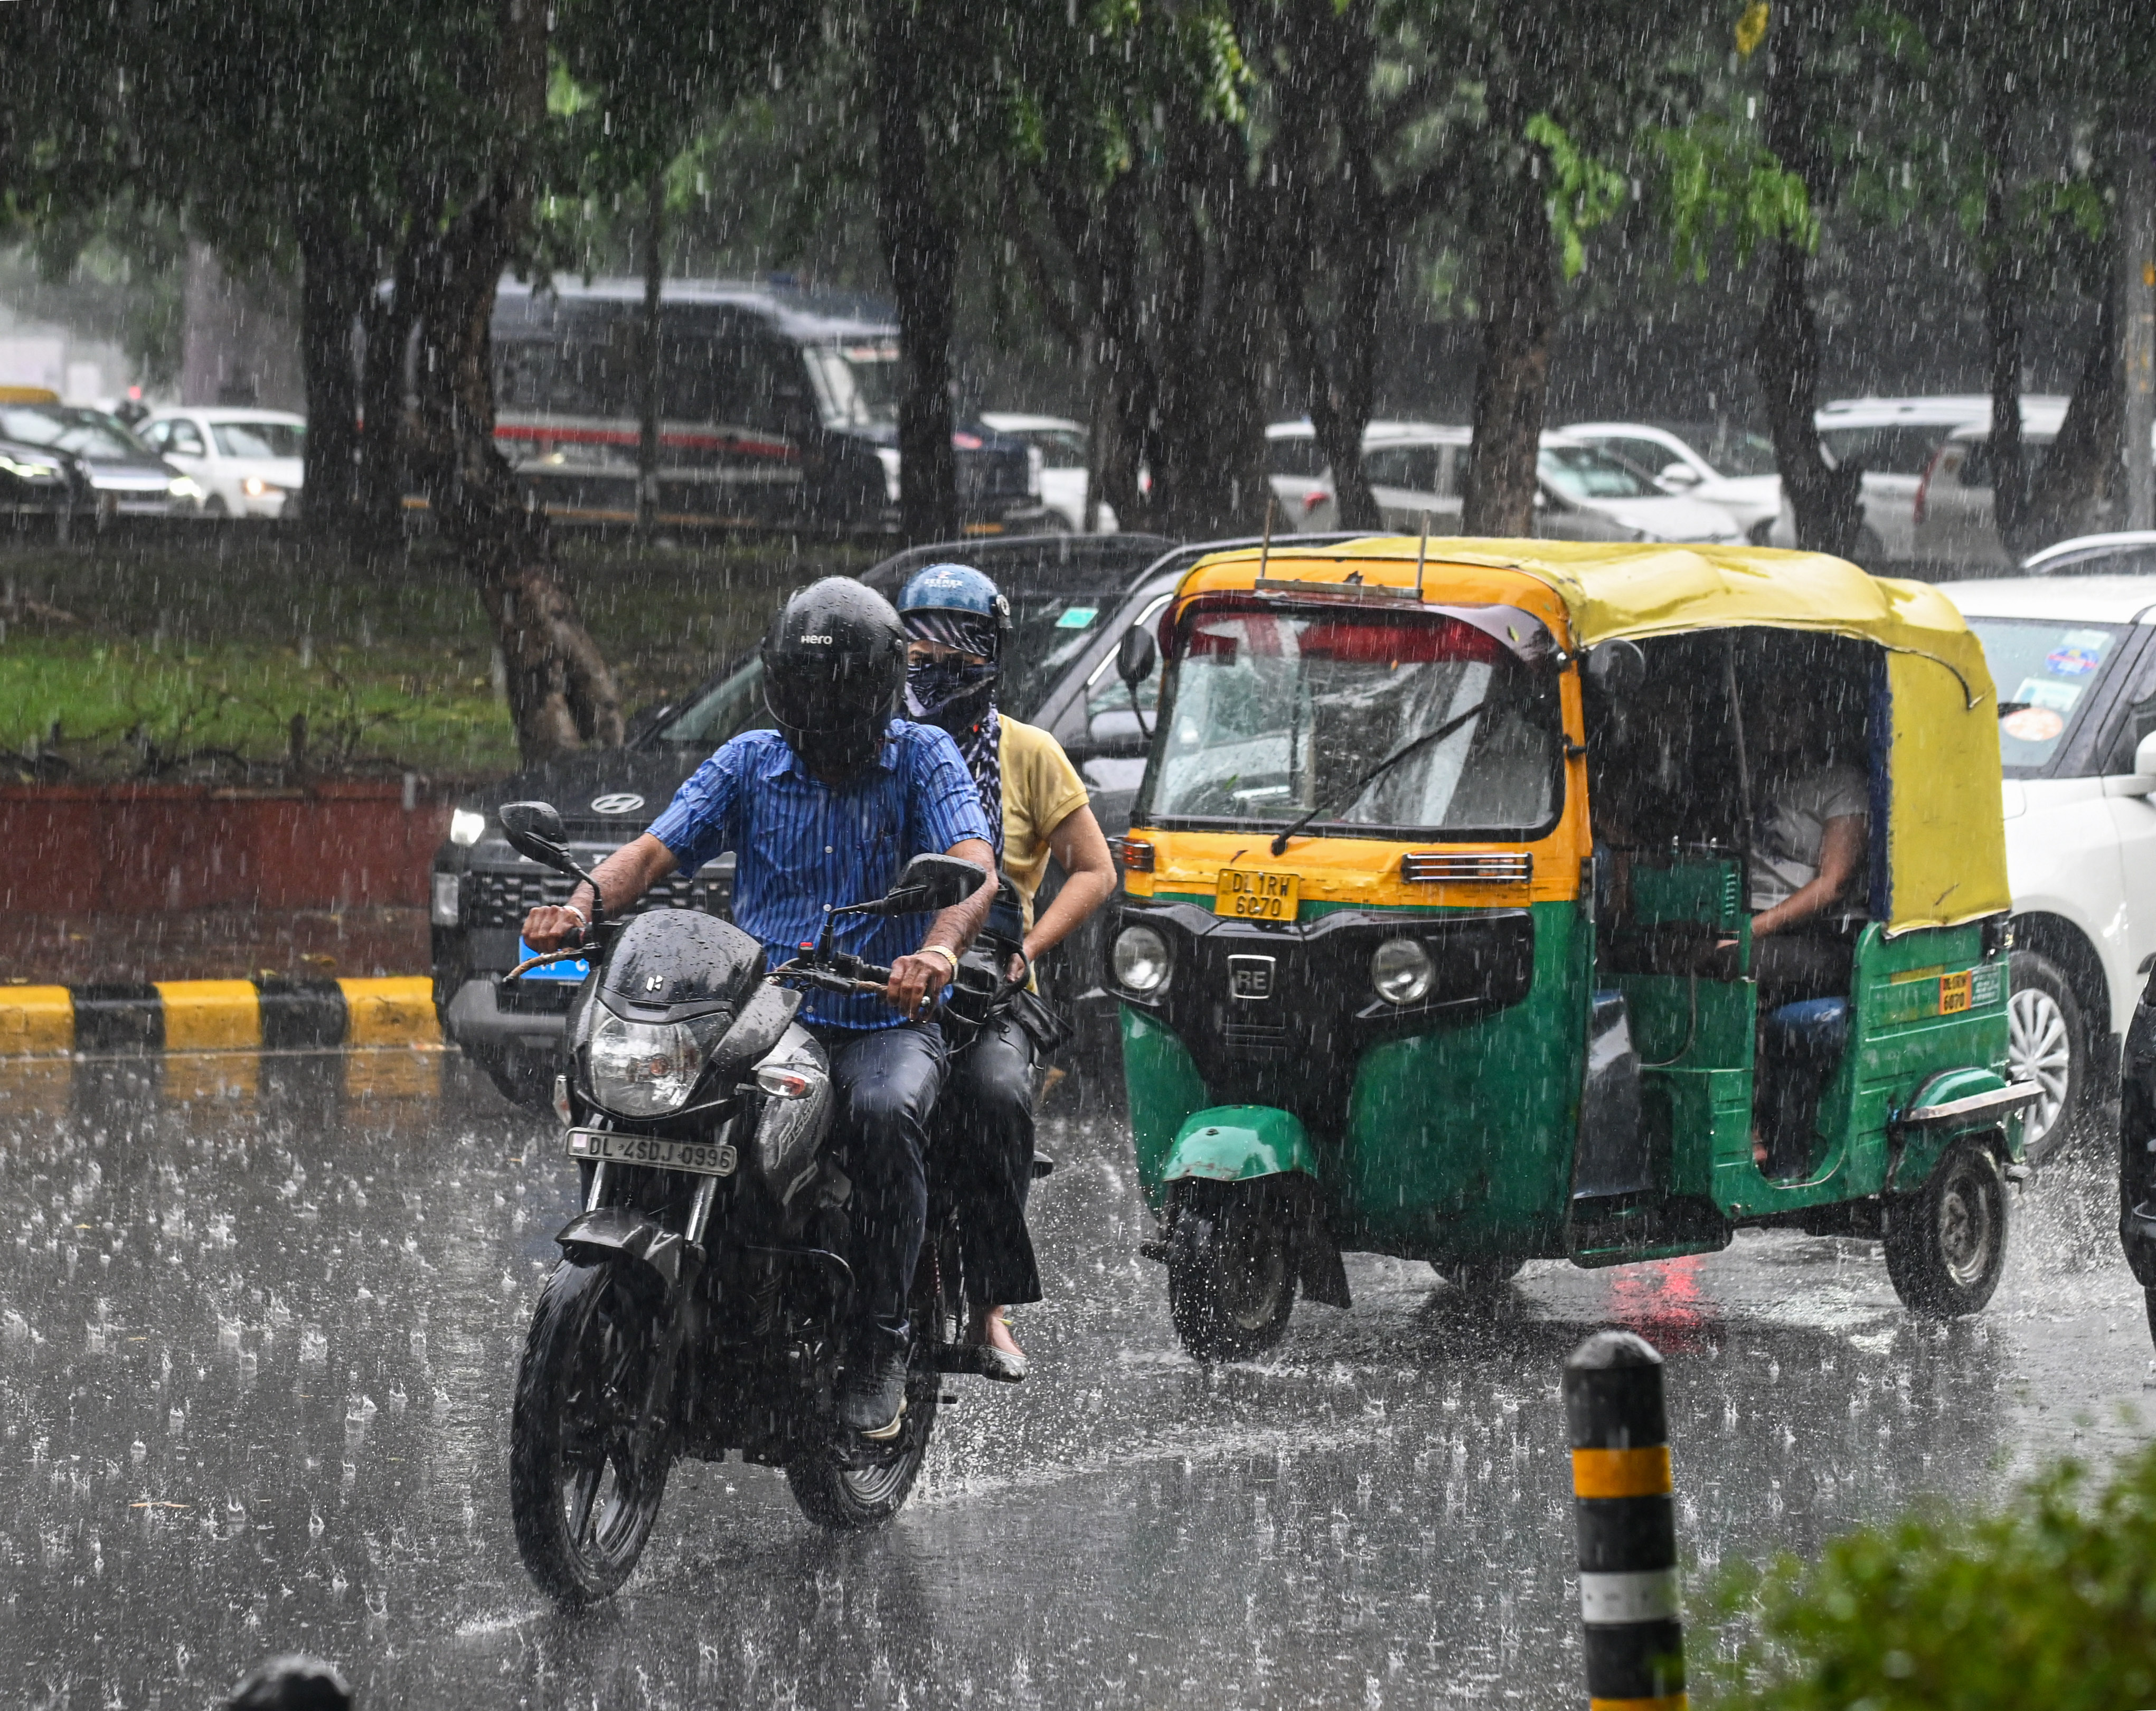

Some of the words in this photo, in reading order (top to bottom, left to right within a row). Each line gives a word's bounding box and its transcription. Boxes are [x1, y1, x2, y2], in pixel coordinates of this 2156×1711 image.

[1236, 895, 1282, 916] 6070
[1237, 970, 1267, 990] RE
[590, 1136, 613, 1157] DL
[624, 1141, 674, 1162] 4SDJ
[681, 1146, 731, 1168] 0996
